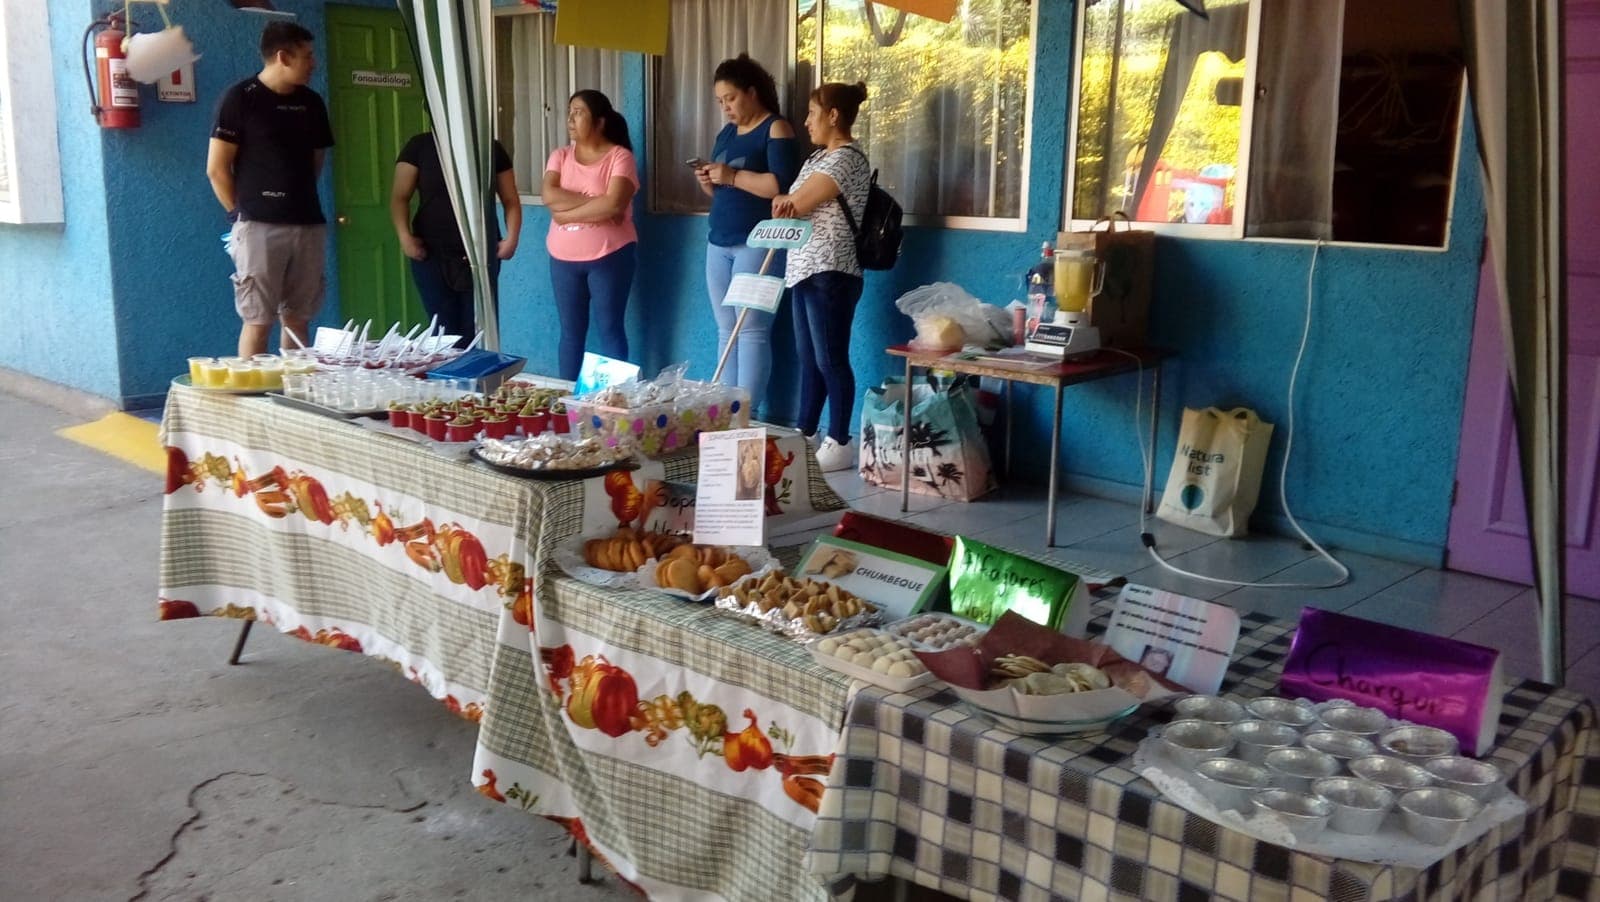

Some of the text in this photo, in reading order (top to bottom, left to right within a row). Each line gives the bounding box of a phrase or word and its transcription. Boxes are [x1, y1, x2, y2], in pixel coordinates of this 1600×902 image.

[753, 227, 803, 241] PULULOS
[1180, 443, 1225, 464] Natura
[1187, 460, 1212, 477] list
[856, 567, 924, 592] CHUMBEQUE
